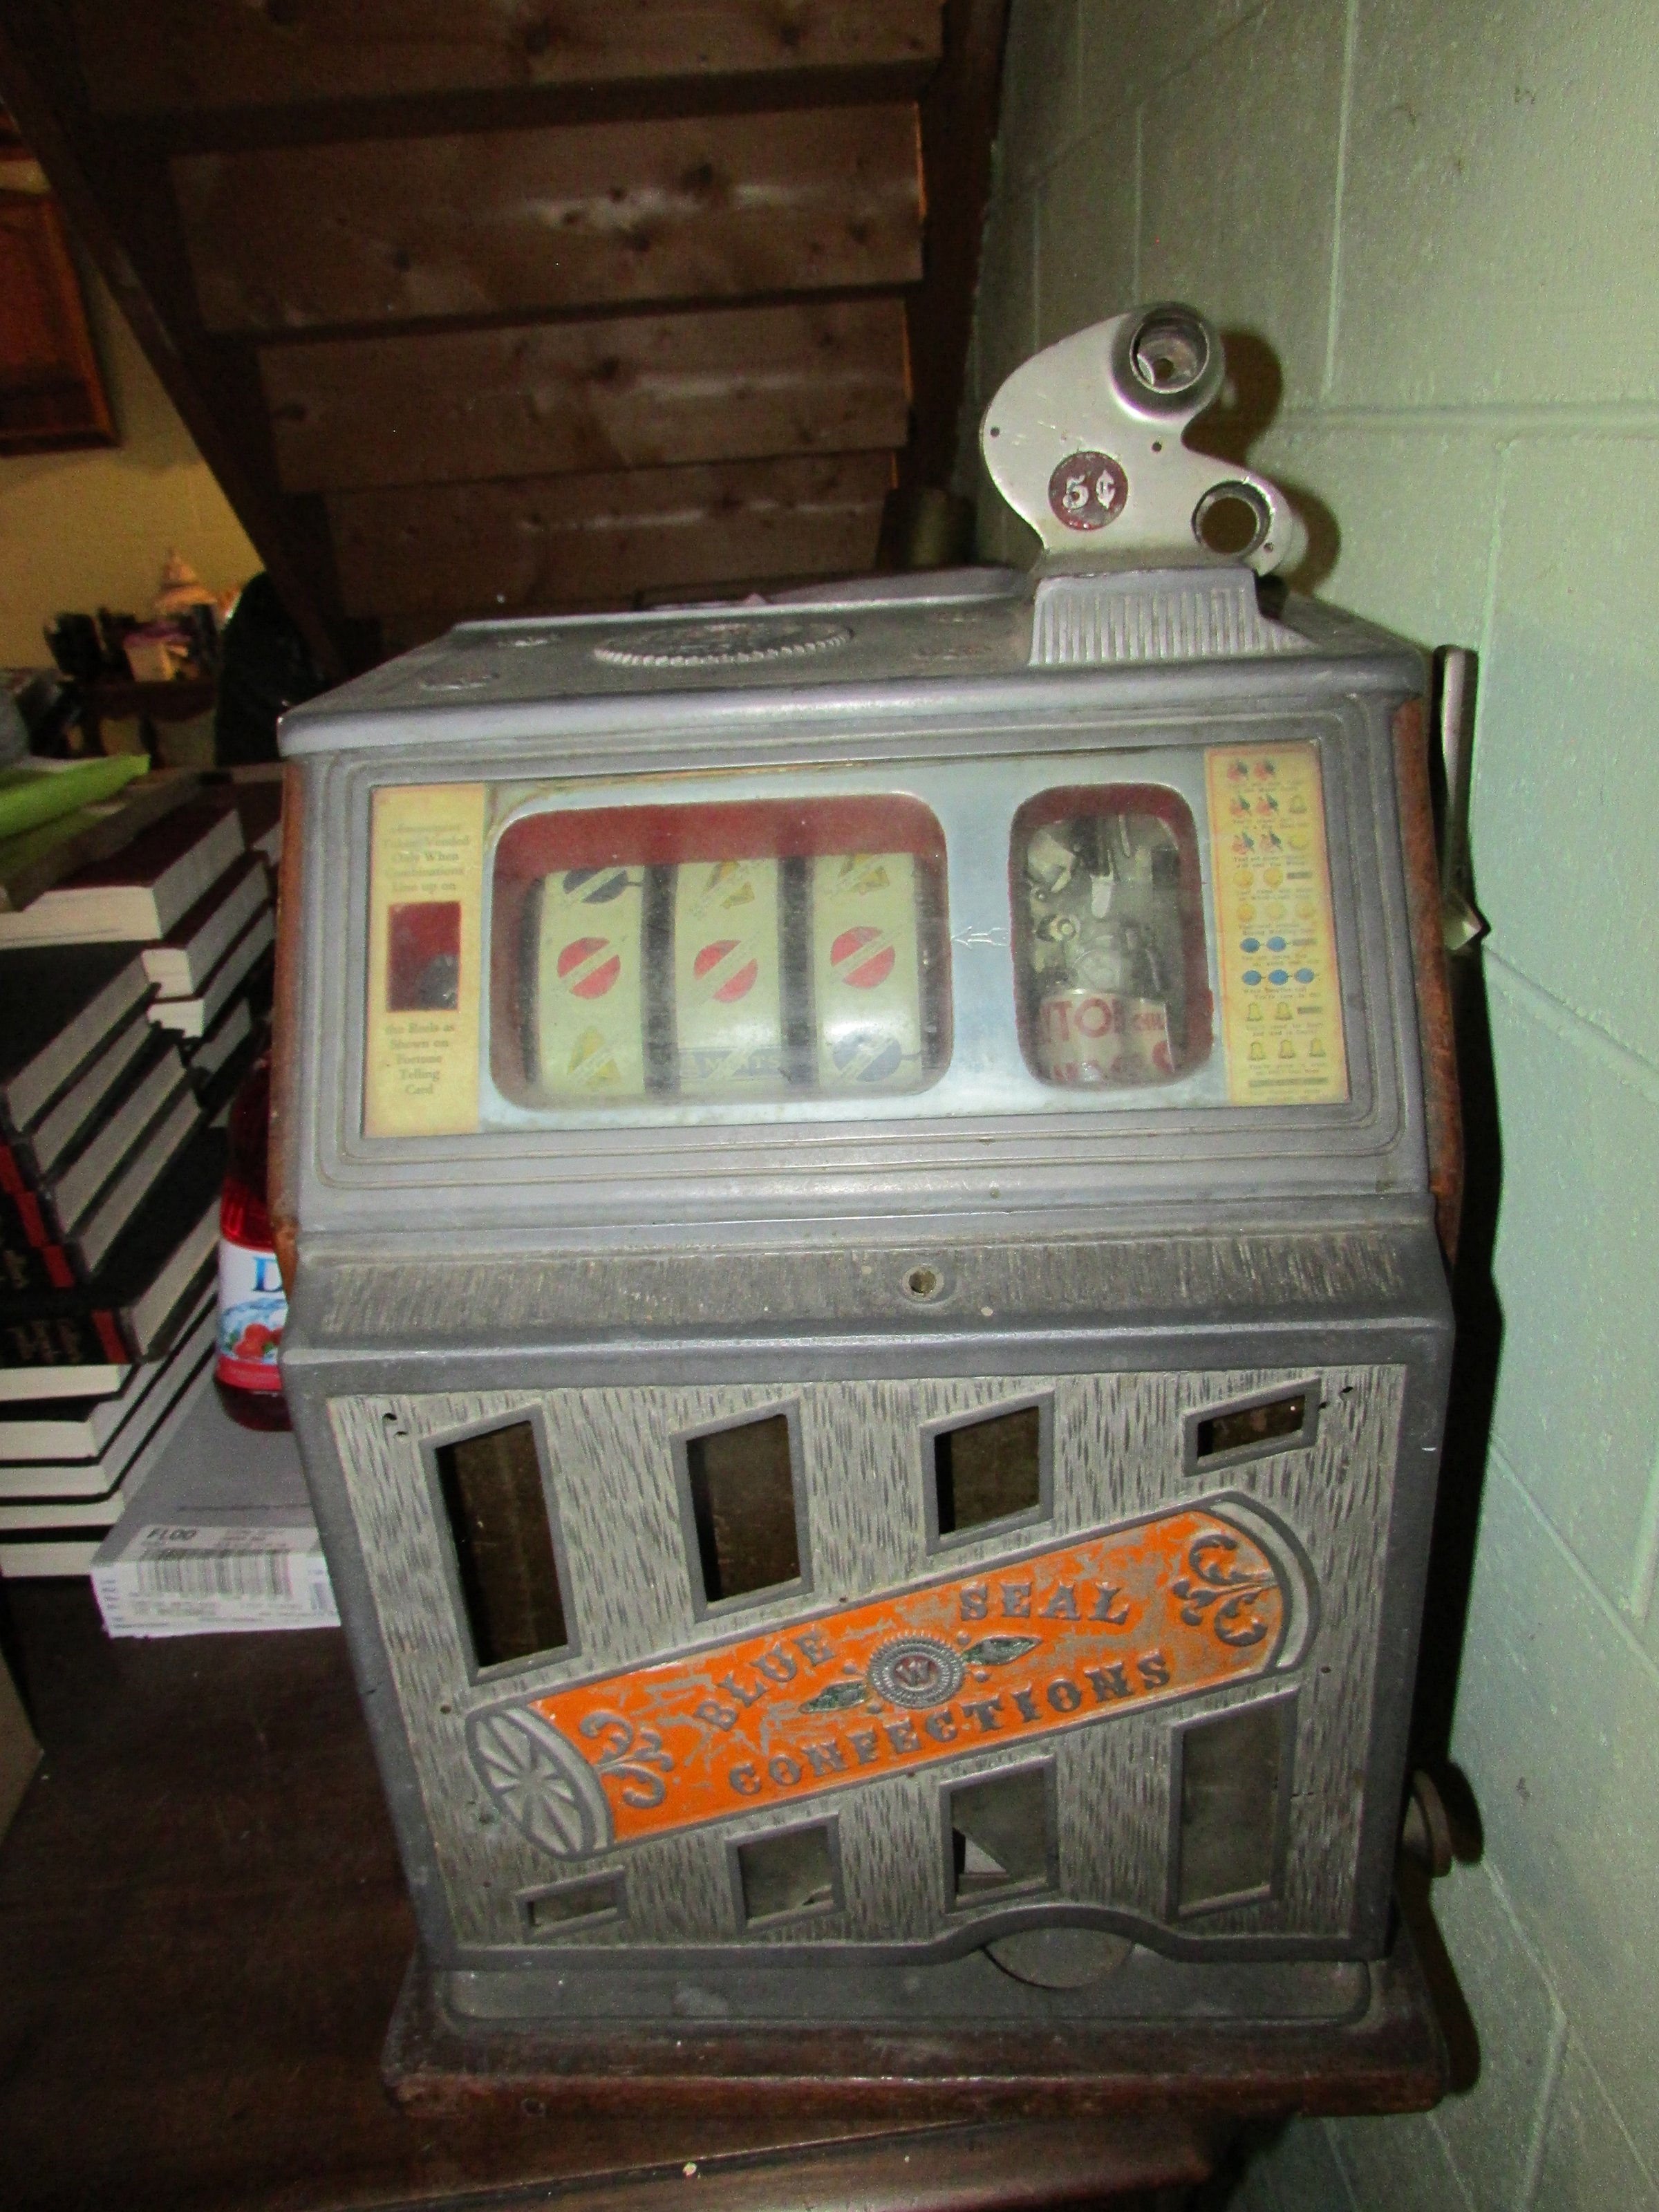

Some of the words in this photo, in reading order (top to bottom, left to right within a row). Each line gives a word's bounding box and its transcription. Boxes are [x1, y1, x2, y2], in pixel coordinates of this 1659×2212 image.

[423, 850, 460, 862] When
[421, 883, 438, 895] up
[441, 882, 457, 891] on
[388, 1039, 430, 1049] Shown
[400, 1068, 440, 1082] Telling
[405, 1083, 433, 1095] Card
[695, 1627, 837, 1732] BLUE
[959, 1580, 1132, 1626] SEAL
[729, 1651, 1172, 1799] CONFECTIONS
